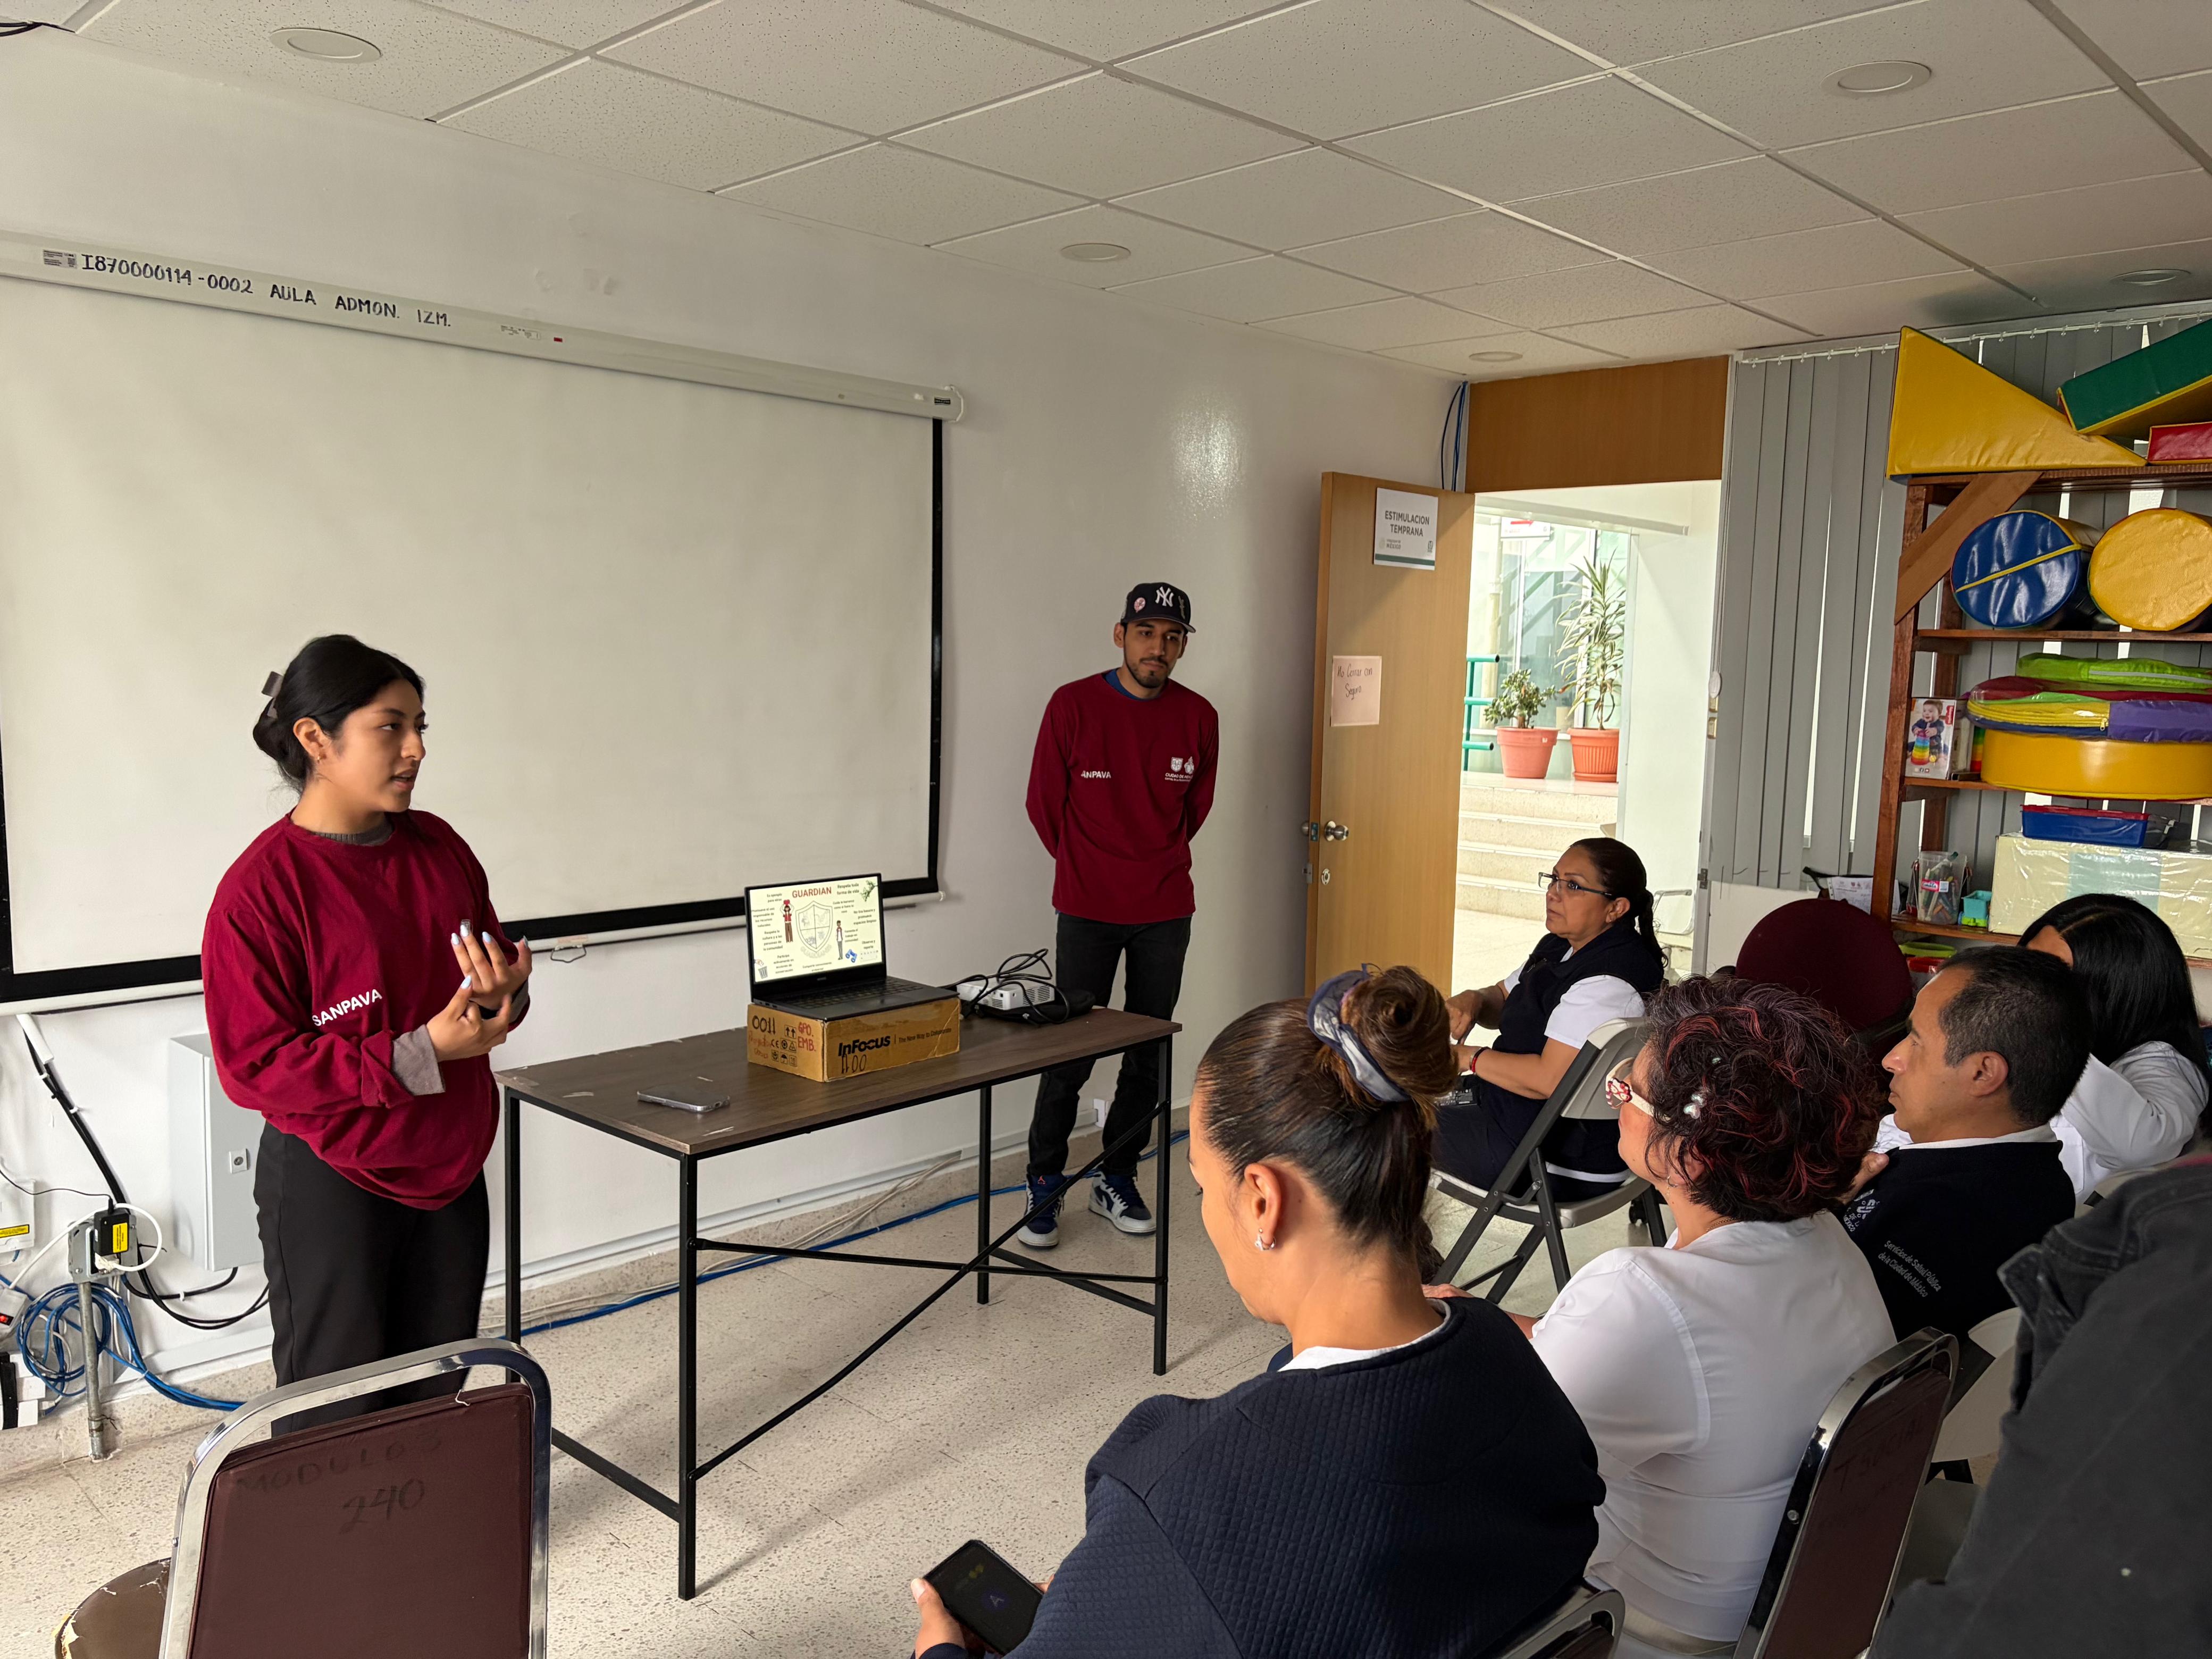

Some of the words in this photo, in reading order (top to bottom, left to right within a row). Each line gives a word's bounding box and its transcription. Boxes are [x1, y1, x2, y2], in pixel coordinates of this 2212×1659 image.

[270, 284, 316, 305] AULA
[335, 296, 400, 319] ADMON.
[417, 309, 451, 326] IZM.
[1385, 510, 1430, 525] ESTIMULACION
[1390, 524, 1423, 537] TEMPRANA
[1155, 586, 1174, 607] NY
[792, 887, 832, 898] GUARDIAN
[312, 989, 382, 1026] SANPAVA
